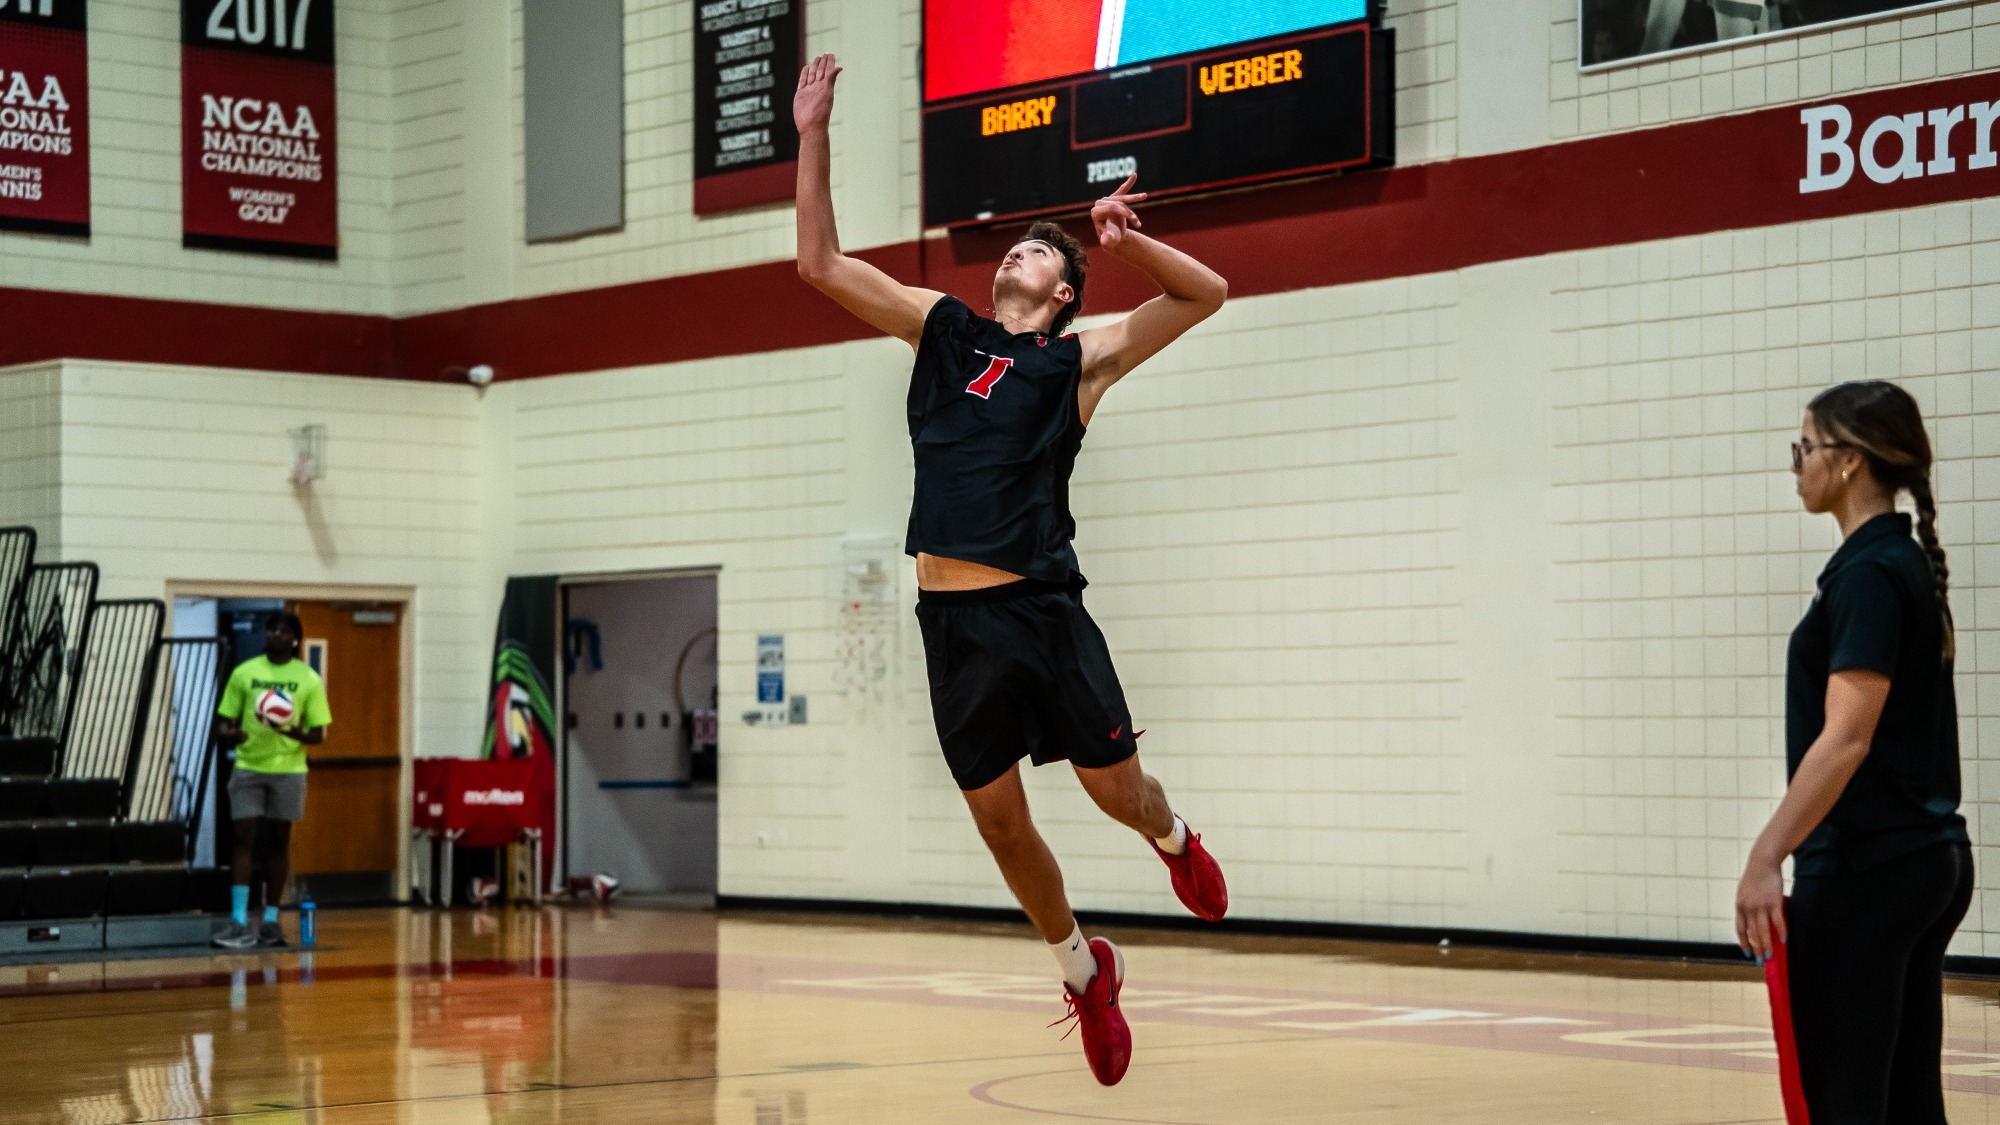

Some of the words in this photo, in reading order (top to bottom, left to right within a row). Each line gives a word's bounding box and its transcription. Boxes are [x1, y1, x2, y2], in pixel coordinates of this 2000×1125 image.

[1200, 49, 1303, 96] WEBBER
[0, 69, 70, 111] AA
[201, 93, 320, 140] NCAA
[982, 96, 1056, 136] BARRY
[202, 130, 321, 162] NATIONAL
[201, 152, 322, 182] CHAMPIONS
[1087, 156, 1138, 183] PERIOD
[229, 187, 296, 208] WOMEN'S
[239, 203, 289, 224] GOLF
